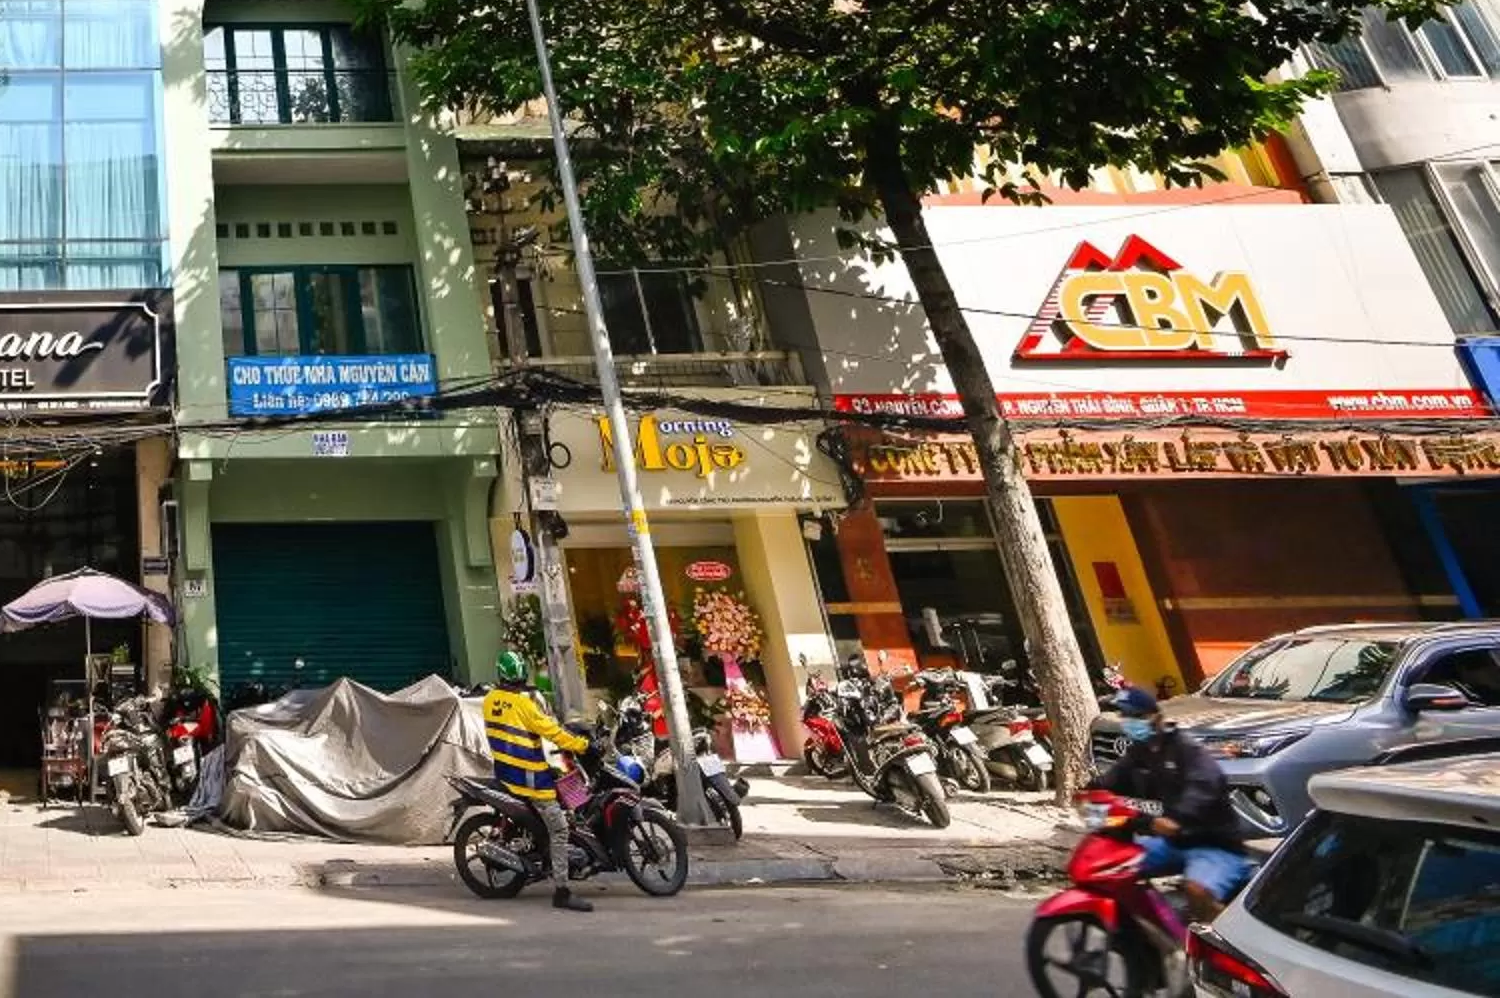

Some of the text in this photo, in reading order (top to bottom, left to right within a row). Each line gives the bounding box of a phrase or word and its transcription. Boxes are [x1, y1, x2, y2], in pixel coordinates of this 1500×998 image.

[1056, 268, 1280, 351] CBM
[233, 366, 261, 385] CHO
[1327, 392, 1473, 411] www.cbm.com.vn
